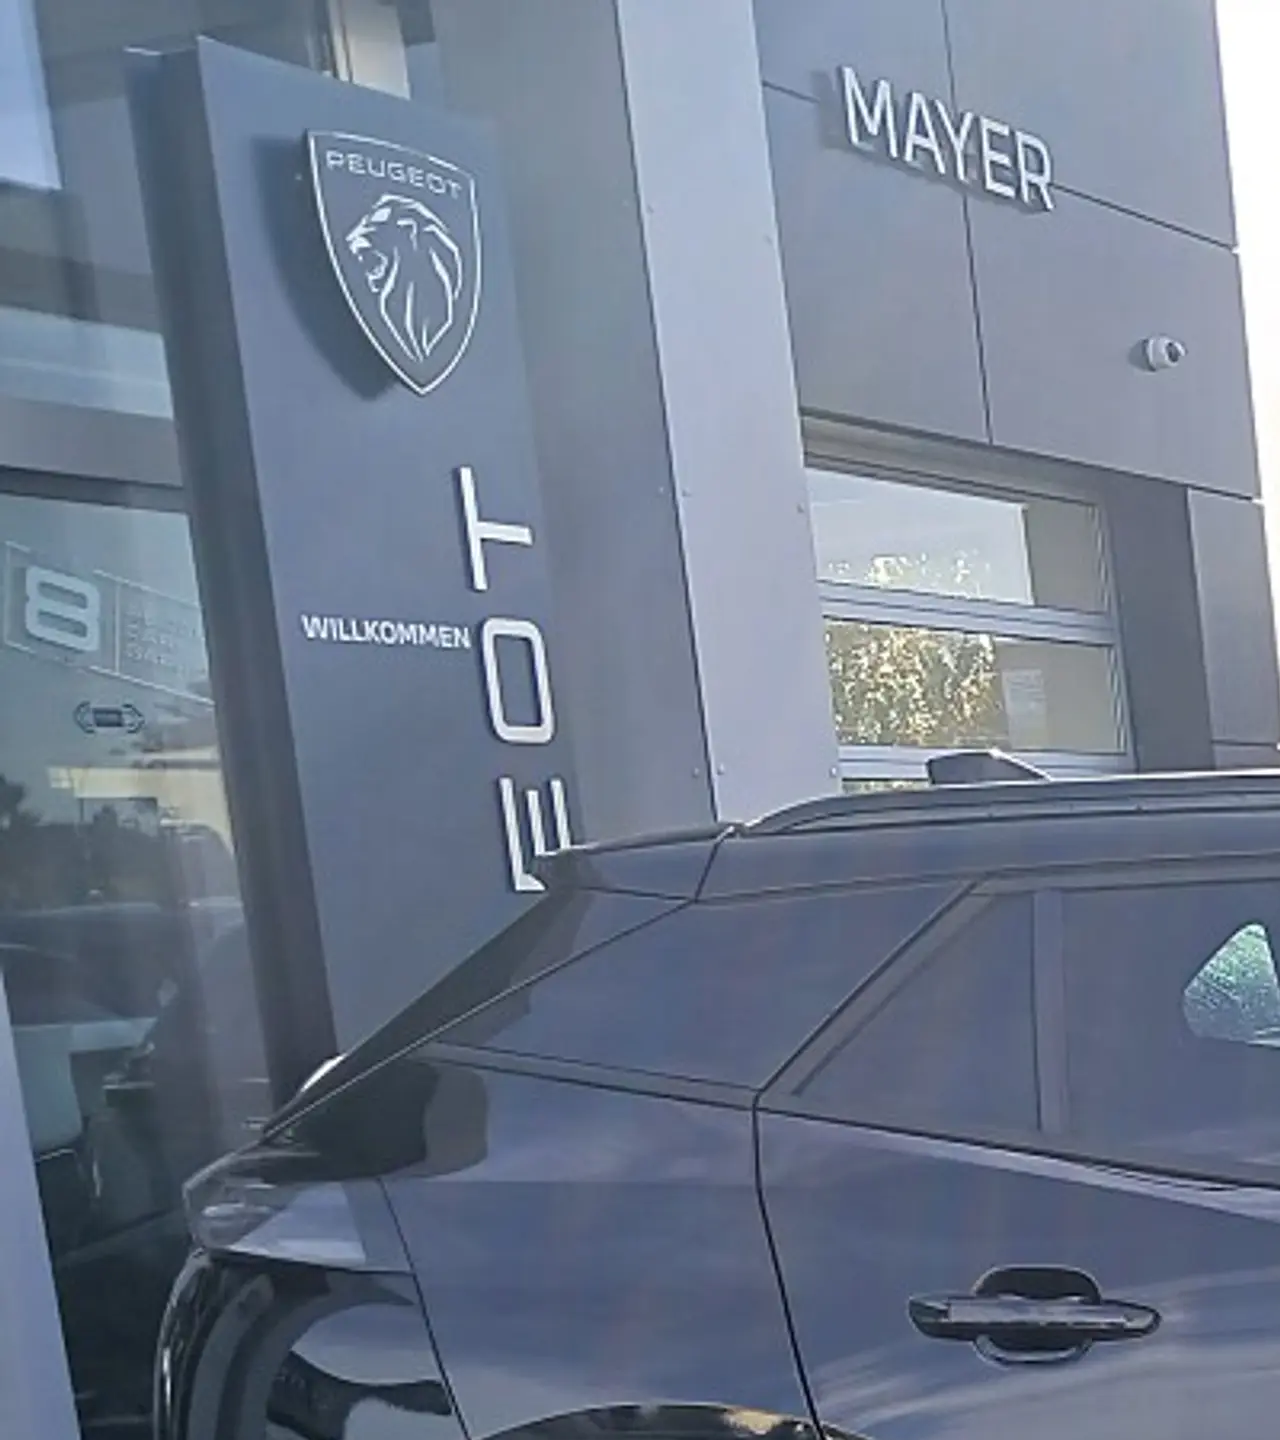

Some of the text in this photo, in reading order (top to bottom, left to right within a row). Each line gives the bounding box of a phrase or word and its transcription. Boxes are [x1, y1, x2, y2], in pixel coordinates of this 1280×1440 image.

[841, 66, 1054, 211] MAYER
[326, 150, 462, 199] PEUGEOT
[301, 614, 471, 649] WILLKOMMEN
